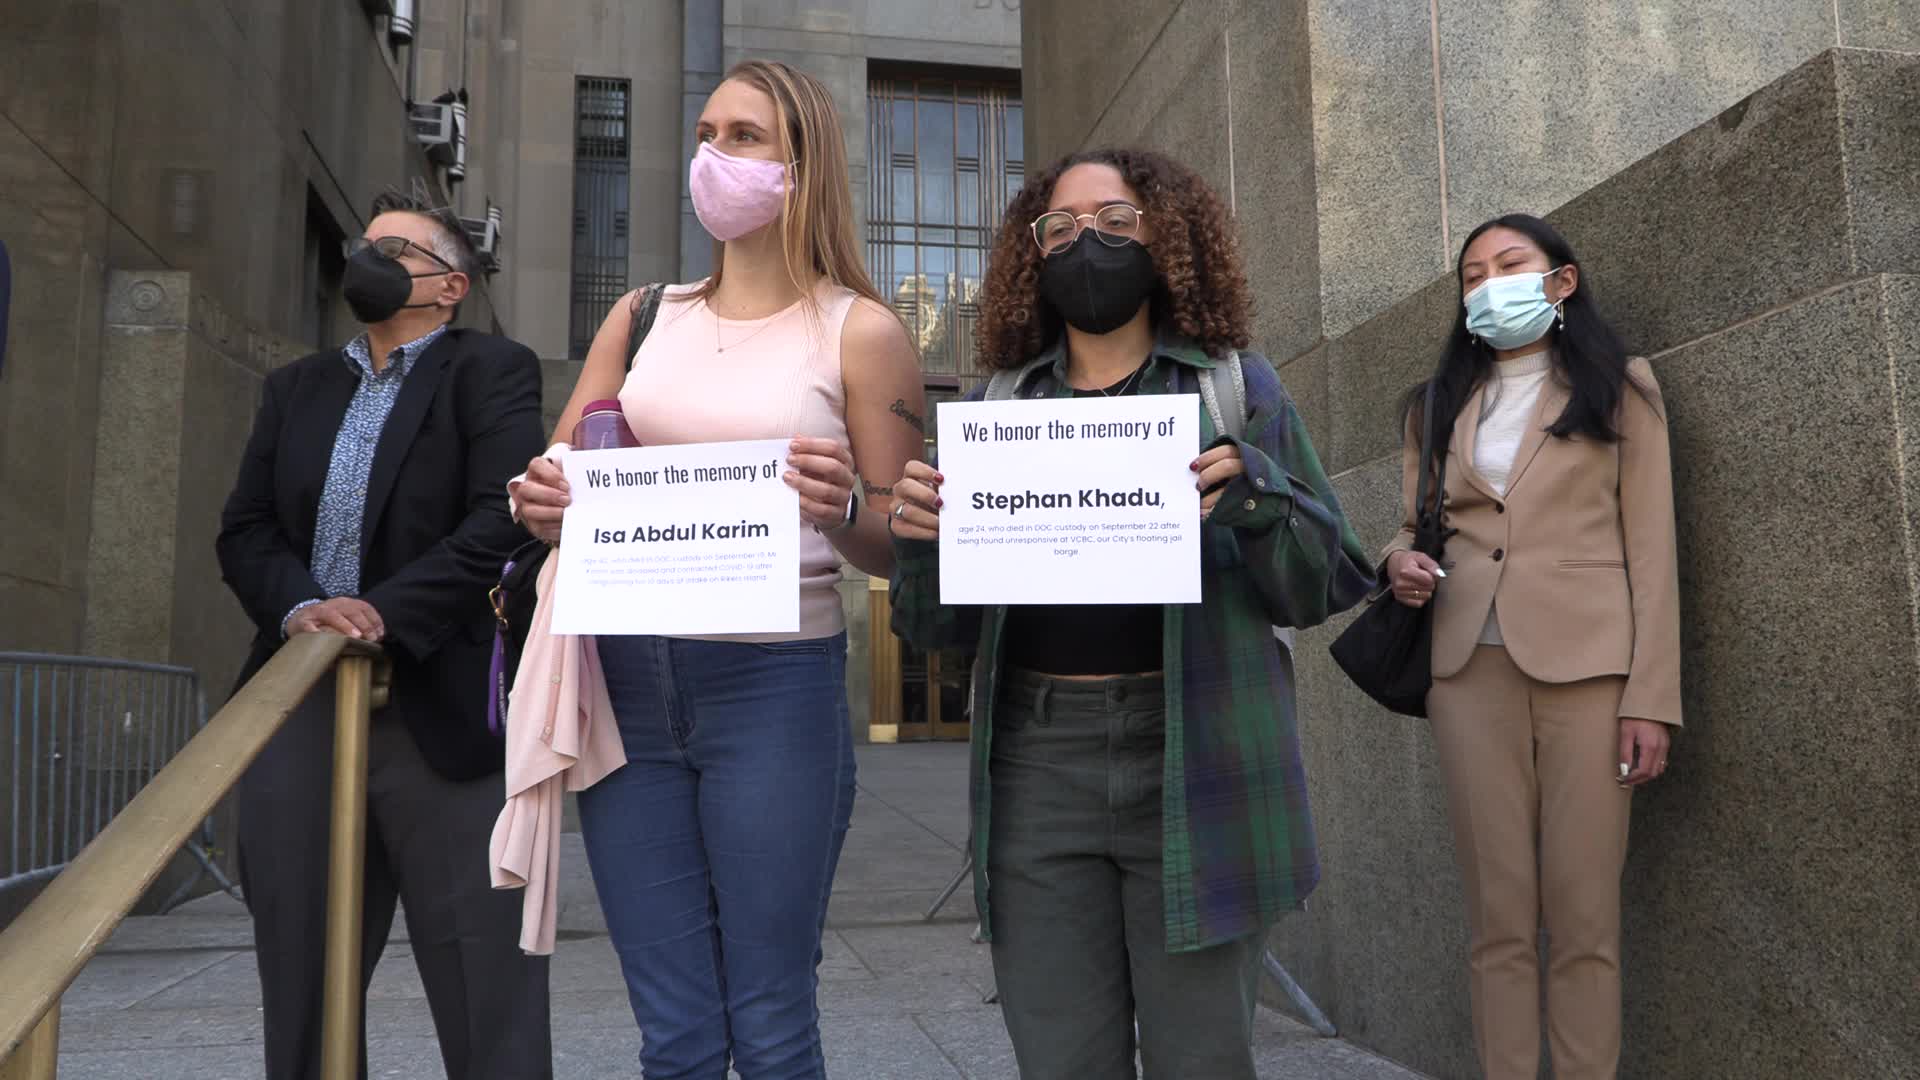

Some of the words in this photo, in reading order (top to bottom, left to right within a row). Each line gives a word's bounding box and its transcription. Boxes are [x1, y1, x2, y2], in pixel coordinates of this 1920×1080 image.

[962, 421, 988, 442] We
[994, 420, 1043, 442] honor
[1047, 419, 1075, 440] the
[1081, 419, 1151, 440] memory
[1157, 416, 1175, 437] of
[586, 469, 611, 489] We
[616, 467, 659, 488] honor
[664, 464, 690, 485] the
[694, 464, 758, 484] memory
[763, 459, 779, 479] of
[971, 489, 1072, 516] Stephan
[1078, 487, 1166, 510] Khadu,
[594, 527, 626, 544] Isa
[631, 523, 697, 544] Abdul
[701, 519, 770, 541] Karim
[957, 537, 980, 547] being
[980, 536, 1004, 545] found
[1005, 535, 1059, 546] unresponsive
[1059, 535, 1069, 544] at
[1097, 536, 1111, 544] our
[1136, 534, 1169, 545] floating
[1169, 534, 1183, 545] jail
[958, 526, 974, 535] age
[988, 524, 1005, 533] who
[1006, 524, 1025, 532] died
[1026, 524, 1034, 532] in
[1034, 523, 1053, 532] DOC
[1054, 523, 1087, 534] custody
[1088, 524, 1099, 532] on
[1100, 522, 1147, 532] September
[1148, 521, 1160, 531] 22
[1160, 521, 1181, 530] after
